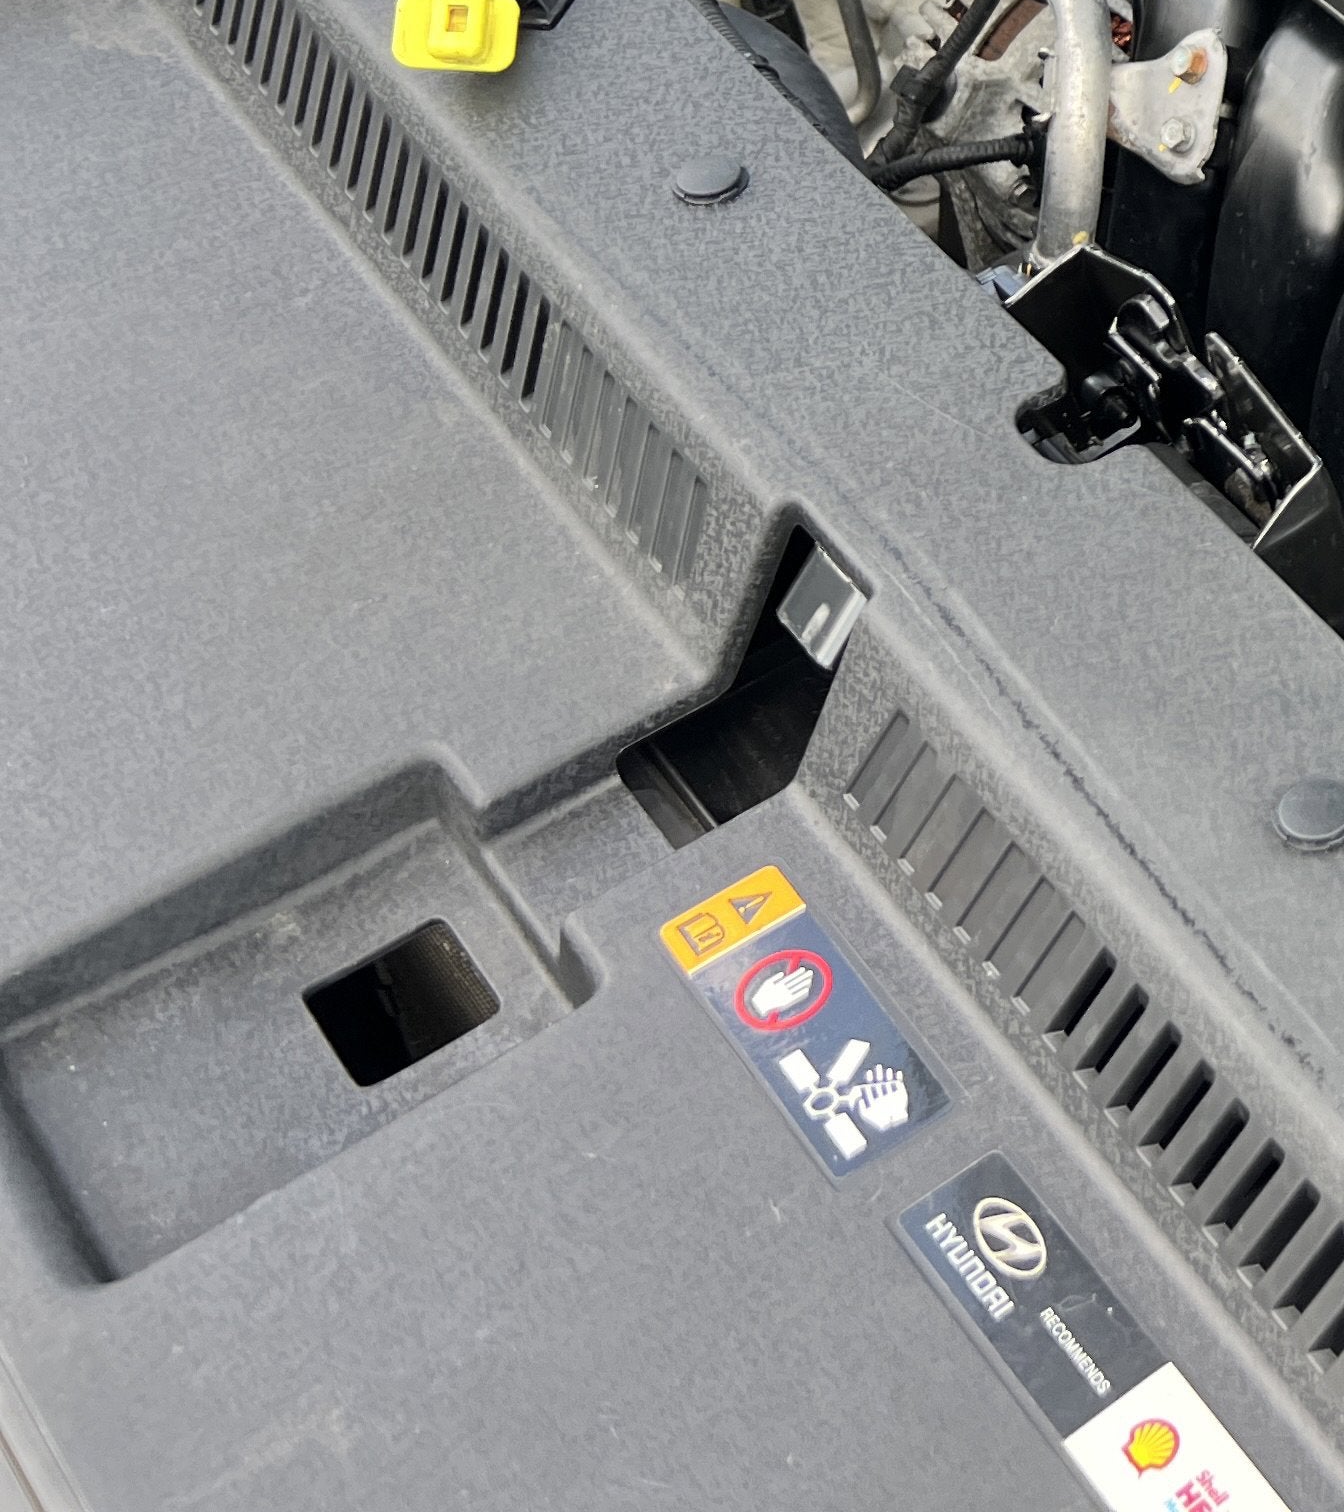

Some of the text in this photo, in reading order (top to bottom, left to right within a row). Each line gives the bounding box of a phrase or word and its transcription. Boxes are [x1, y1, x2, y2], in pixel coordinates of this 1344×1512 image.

[924, 1212, 1015, 1323] HYUNDAI
[1040, 1306, 1112, 1397] RECOMMENDS
[1195, 1469, 1230, 1507] Shell
